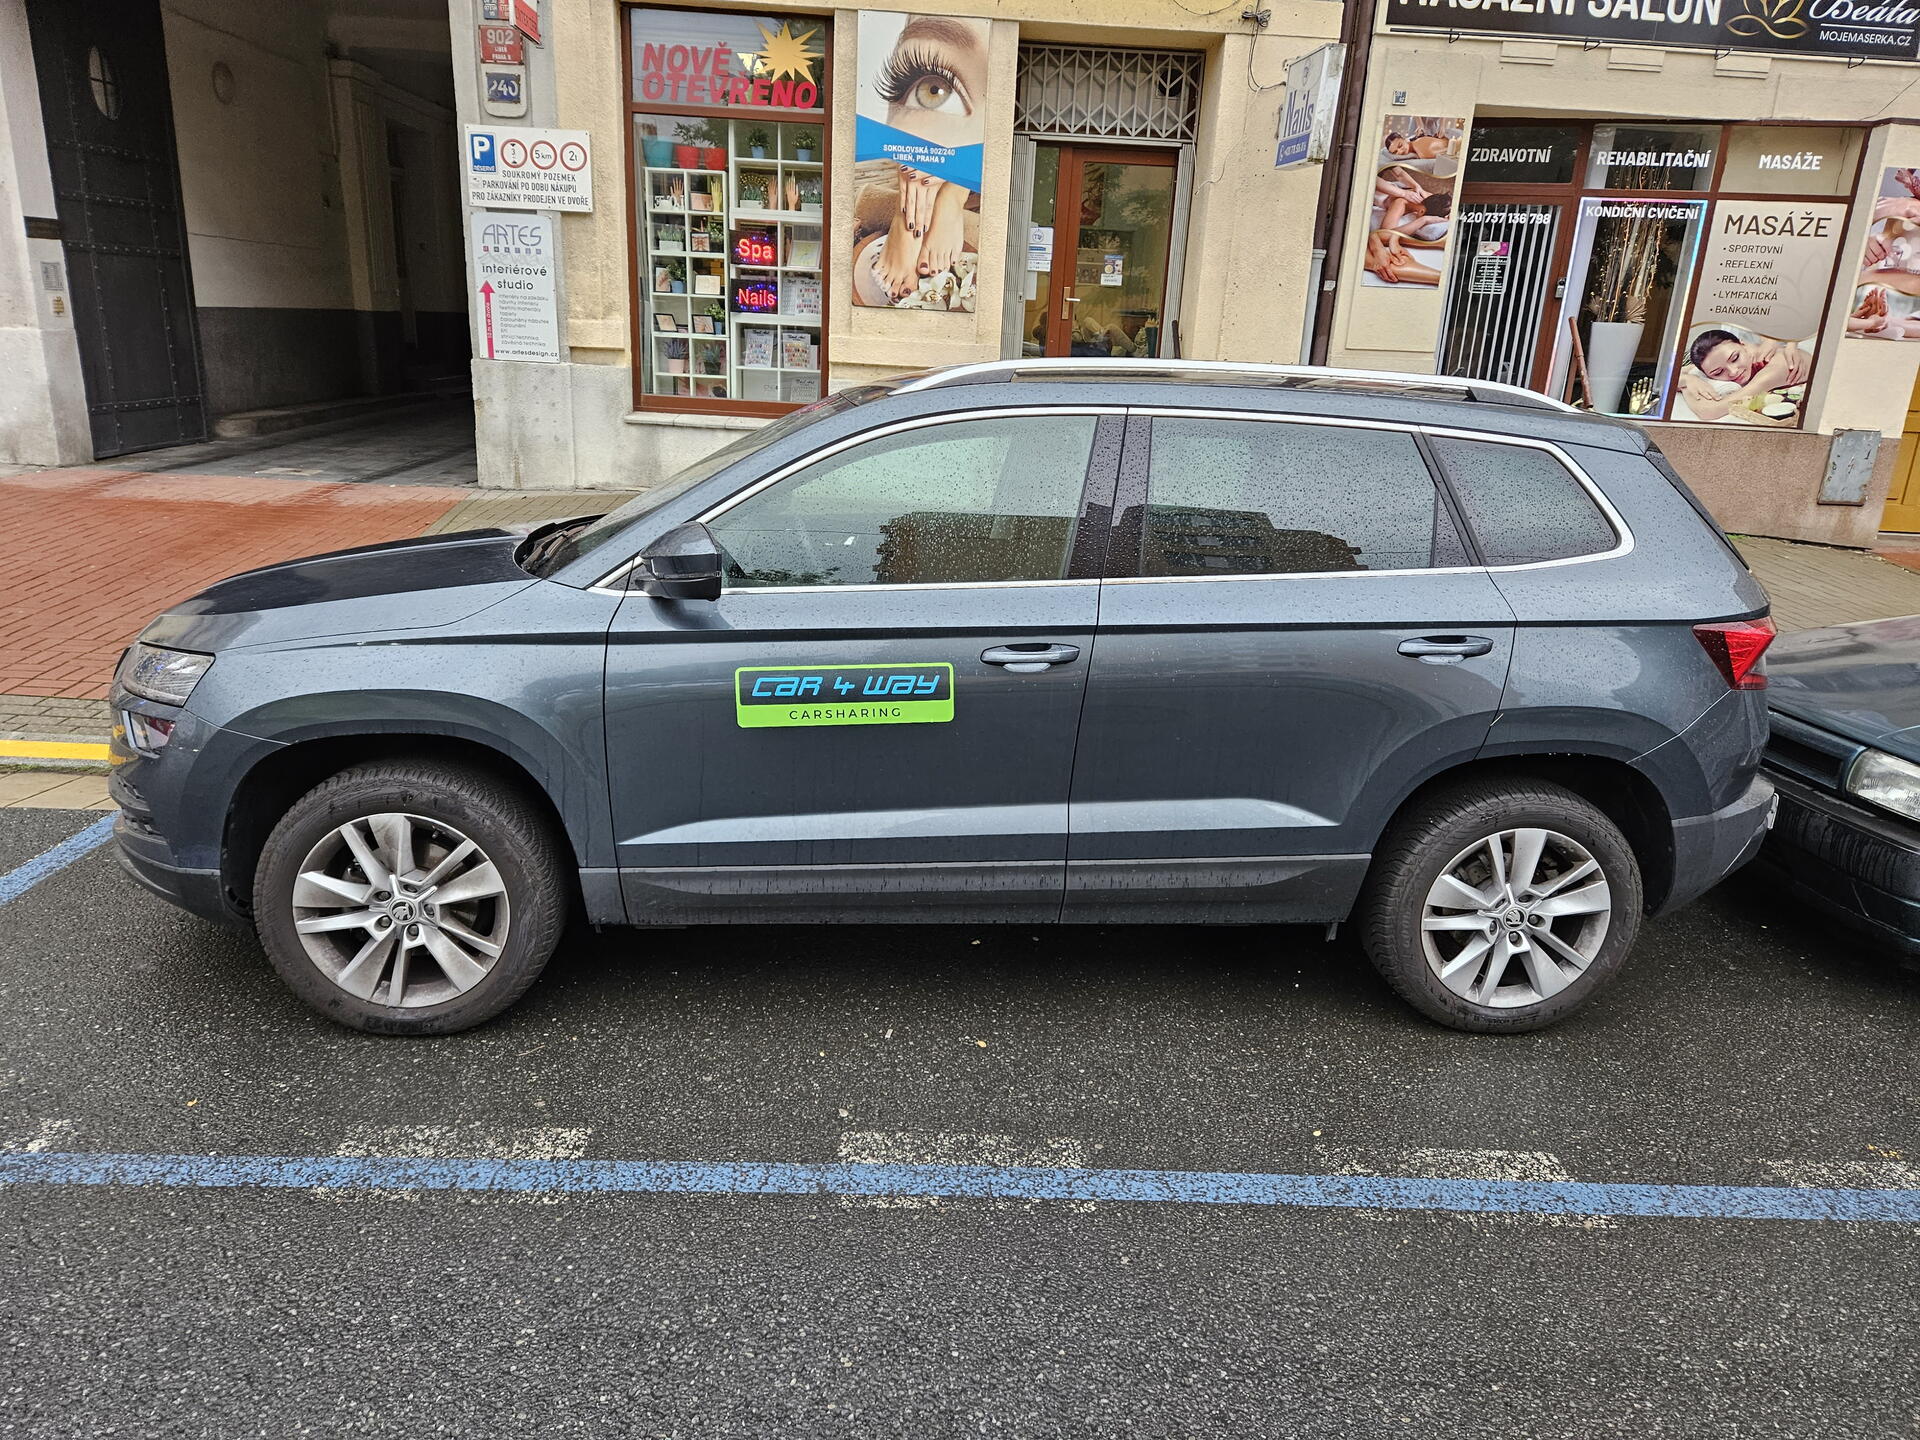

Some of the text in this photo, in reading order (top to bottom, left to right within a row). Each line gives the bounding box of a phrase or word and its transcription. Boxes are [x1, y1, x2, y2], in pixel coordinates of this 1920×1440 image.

[486, 29, 514, 45] 902
[1819, 30, 1912, 46] MOJEMASERKA.CZ
[641, 41, 733, 77] NOVĚ
[488, 79, 519, 97] 240
[642, 70, 818, 110] OTEVŘENO
[1284, 89, 1314, 138] Nails
[473, 136, 491, 160] P
[883, 144, 956, 156] SOKOLOVSKÁ 902/240
[892, 153, 915, 163] LIBEŇ,
[916, 155, 939, 163] PRAHA
[1471, 145, 1824, 170] ZDRAVOTNÍ REHABILITAČNÍ MASÁŽE
[502, 170, 576, 182] SOUKROMÝ POZEMEK
[482, 180, 577, 193] PARKOVÁNÍ PO DOBU NÁKUPU
[472, 191, 589, 206] PRO ZÁKAZNÍKY PRODEJEN VE DVOŘE
[1485, 212, 1507, 223] 737
[1507, 212, 1527, 224] 136
[1529, 213, 1552, 224] 798
[1585, 204, 1700, 220] KONDIČNÍ CVIČENÍ
[1723, 211, 1832, 238] MASÁŽE
[482, 224, 542, 246] ARTES
[738, 238, 773, 261] Spa
[1728, 244, 1784, 255] SPORTOVNÍ
[482, 263, 547, 276] interiérové
[1724, 259, 1774, 269] REFLEXNÍ
[497, 279, 534, 290] studio
[1721, 274, 1779, 285] RELAXAČNÍ
[738, 288, 776, 306] Nails
[1718, 290, 1778, 301] LYMFATICKÁ
[1715, 304, 1771, 316] BAŇKOVÁNÍ
[495, 349, 558, 357] www.artesdesign.cz
[833, 676, 856, 696] 4
[789, 707, 902, 720] CARSHARING
